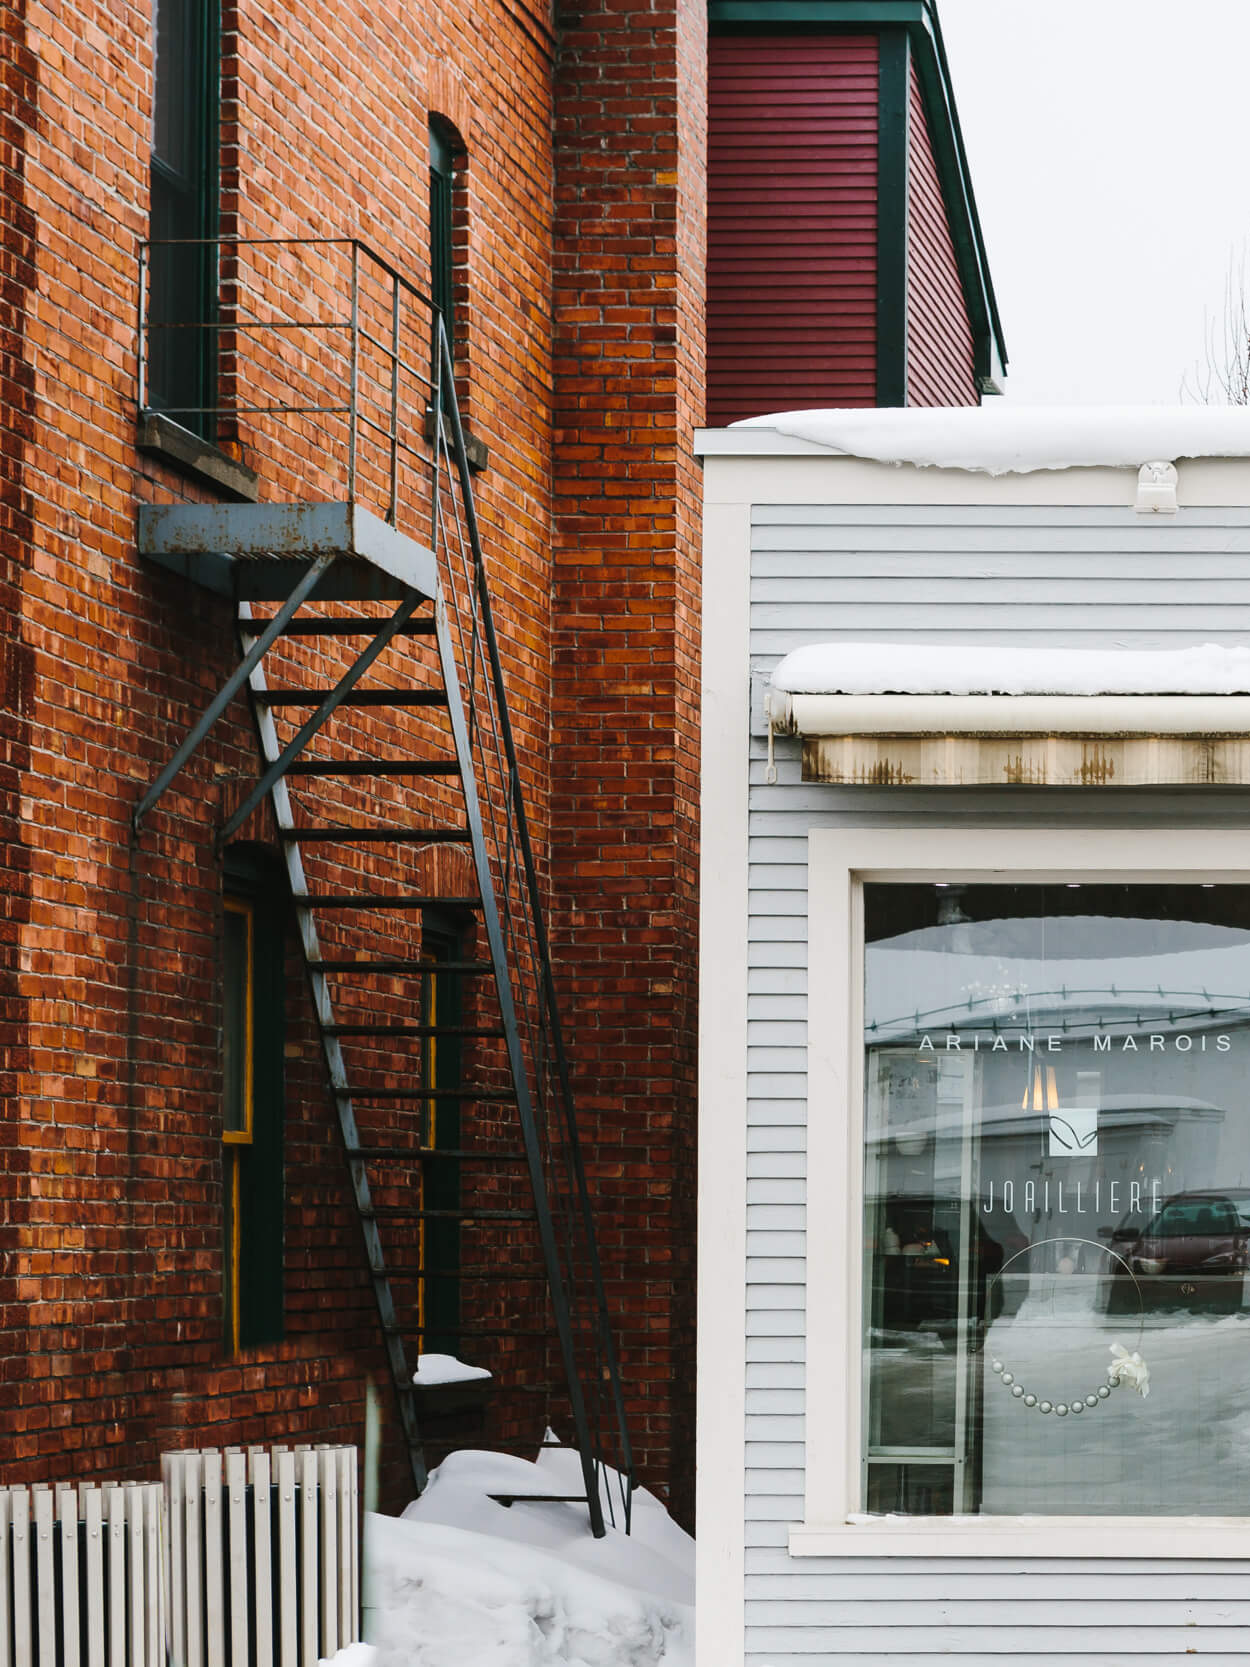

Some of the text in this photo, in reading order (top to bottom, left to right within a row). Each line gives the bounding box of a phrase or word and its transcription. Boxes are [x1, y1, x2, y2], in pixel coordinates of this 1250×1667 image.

[919, 1035, 1233, 1052] ARIANE MAROIS
[983, 1180, 1163, 1214] JOAILLIERE
